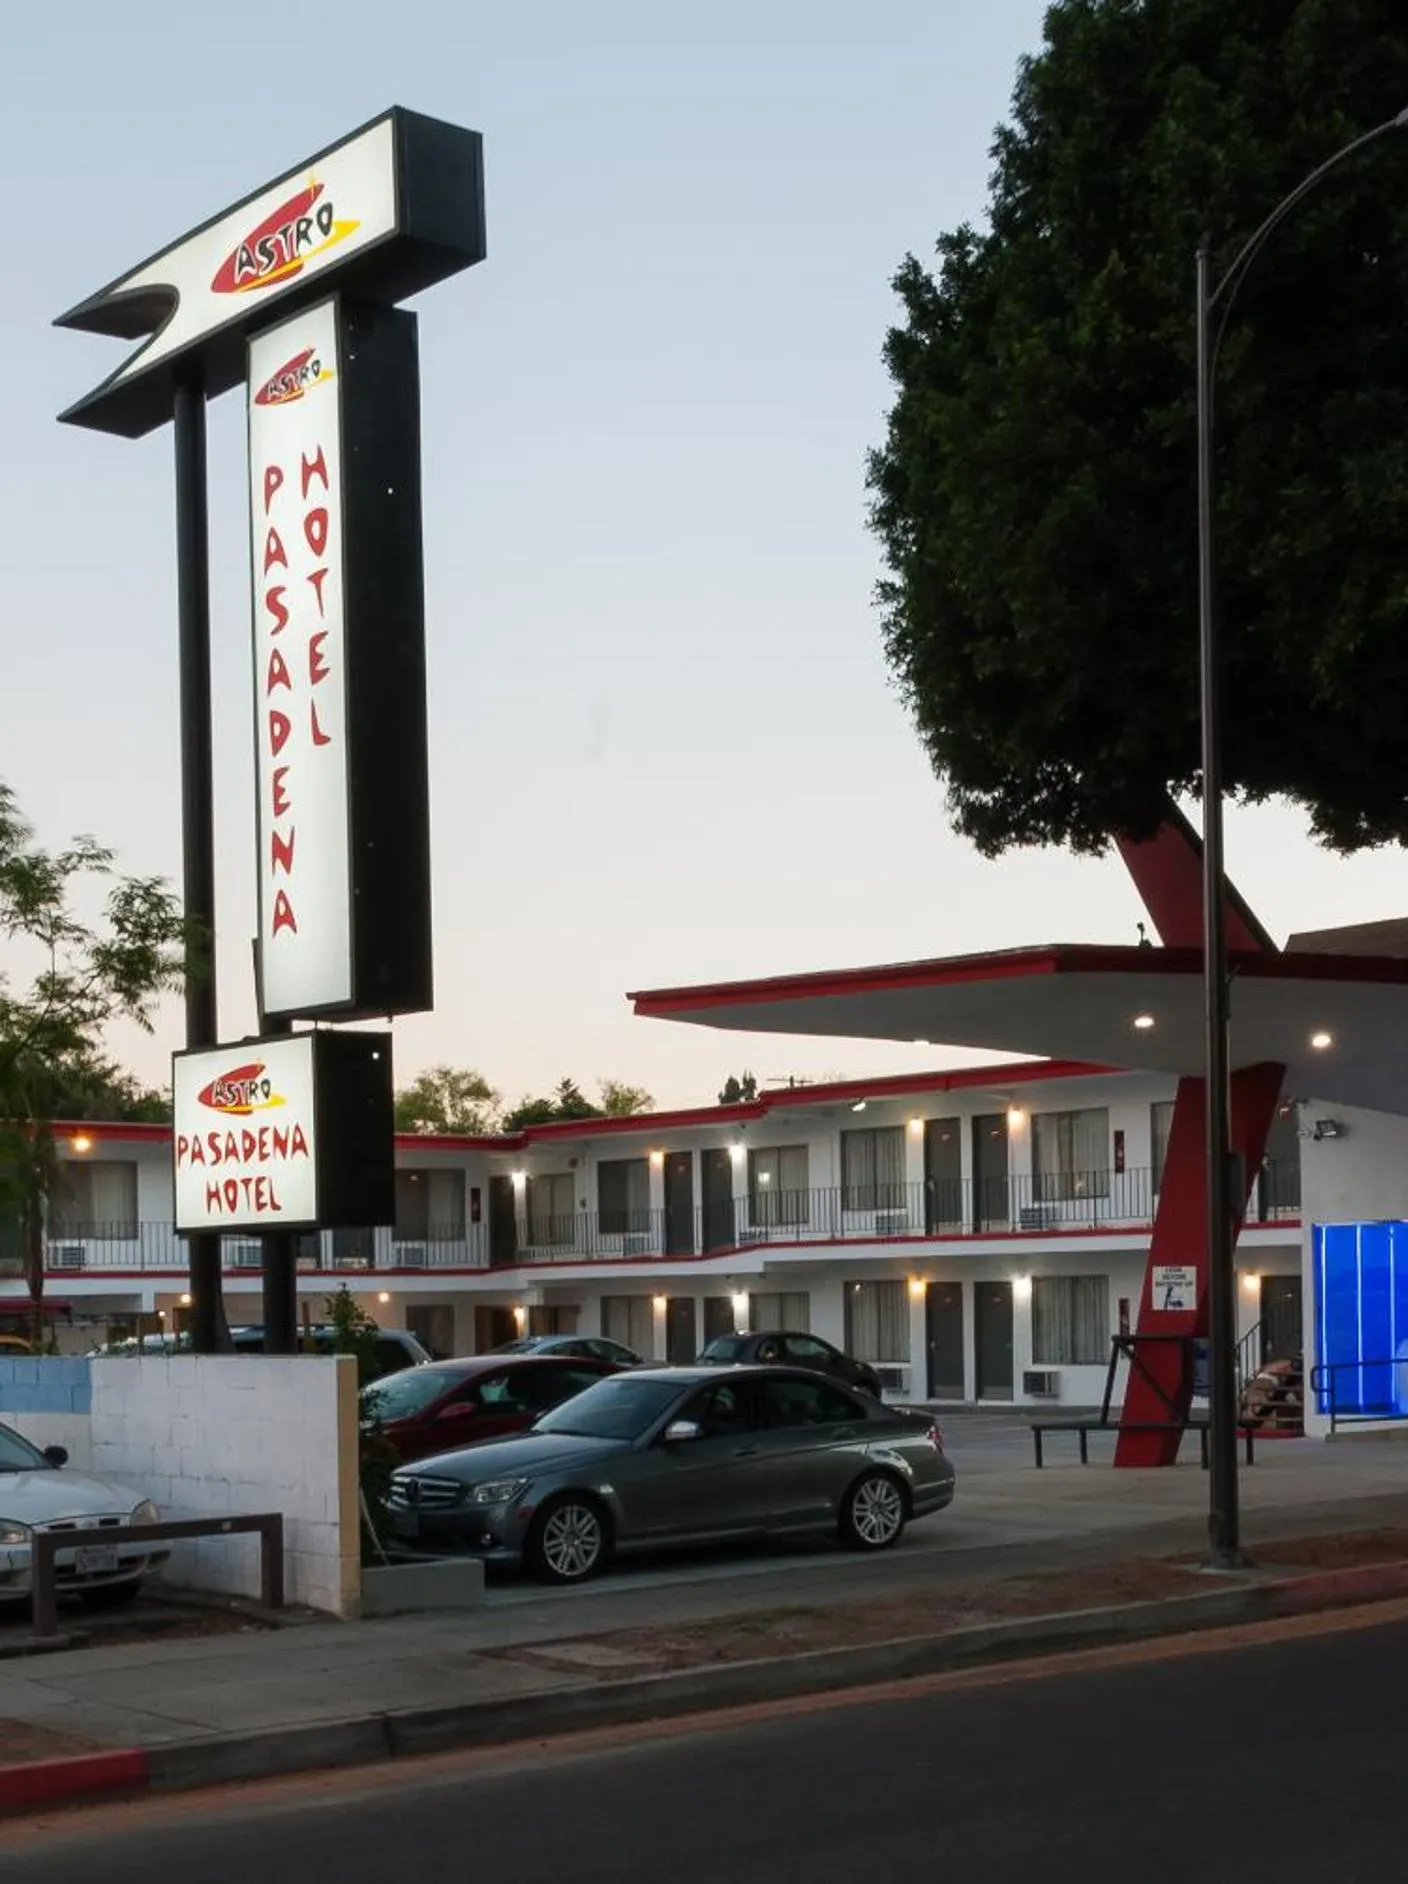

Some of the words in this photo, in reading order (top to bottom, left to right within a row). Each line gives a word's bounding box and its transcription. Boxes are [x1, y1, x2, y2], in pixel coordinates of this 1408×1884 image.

[235, 202, 333, 283] ASTRO
[268, 360, 321, 399] ASTRO
[301, 445, 331, 746] HOTEL
[264, 465, 298, 938] PASADENA
[212, 1079, 271, 1106] ASTRO
[177, 1122, 309, 1168] PASADENA
[206, 1176, 282, 1213] HOTEL
